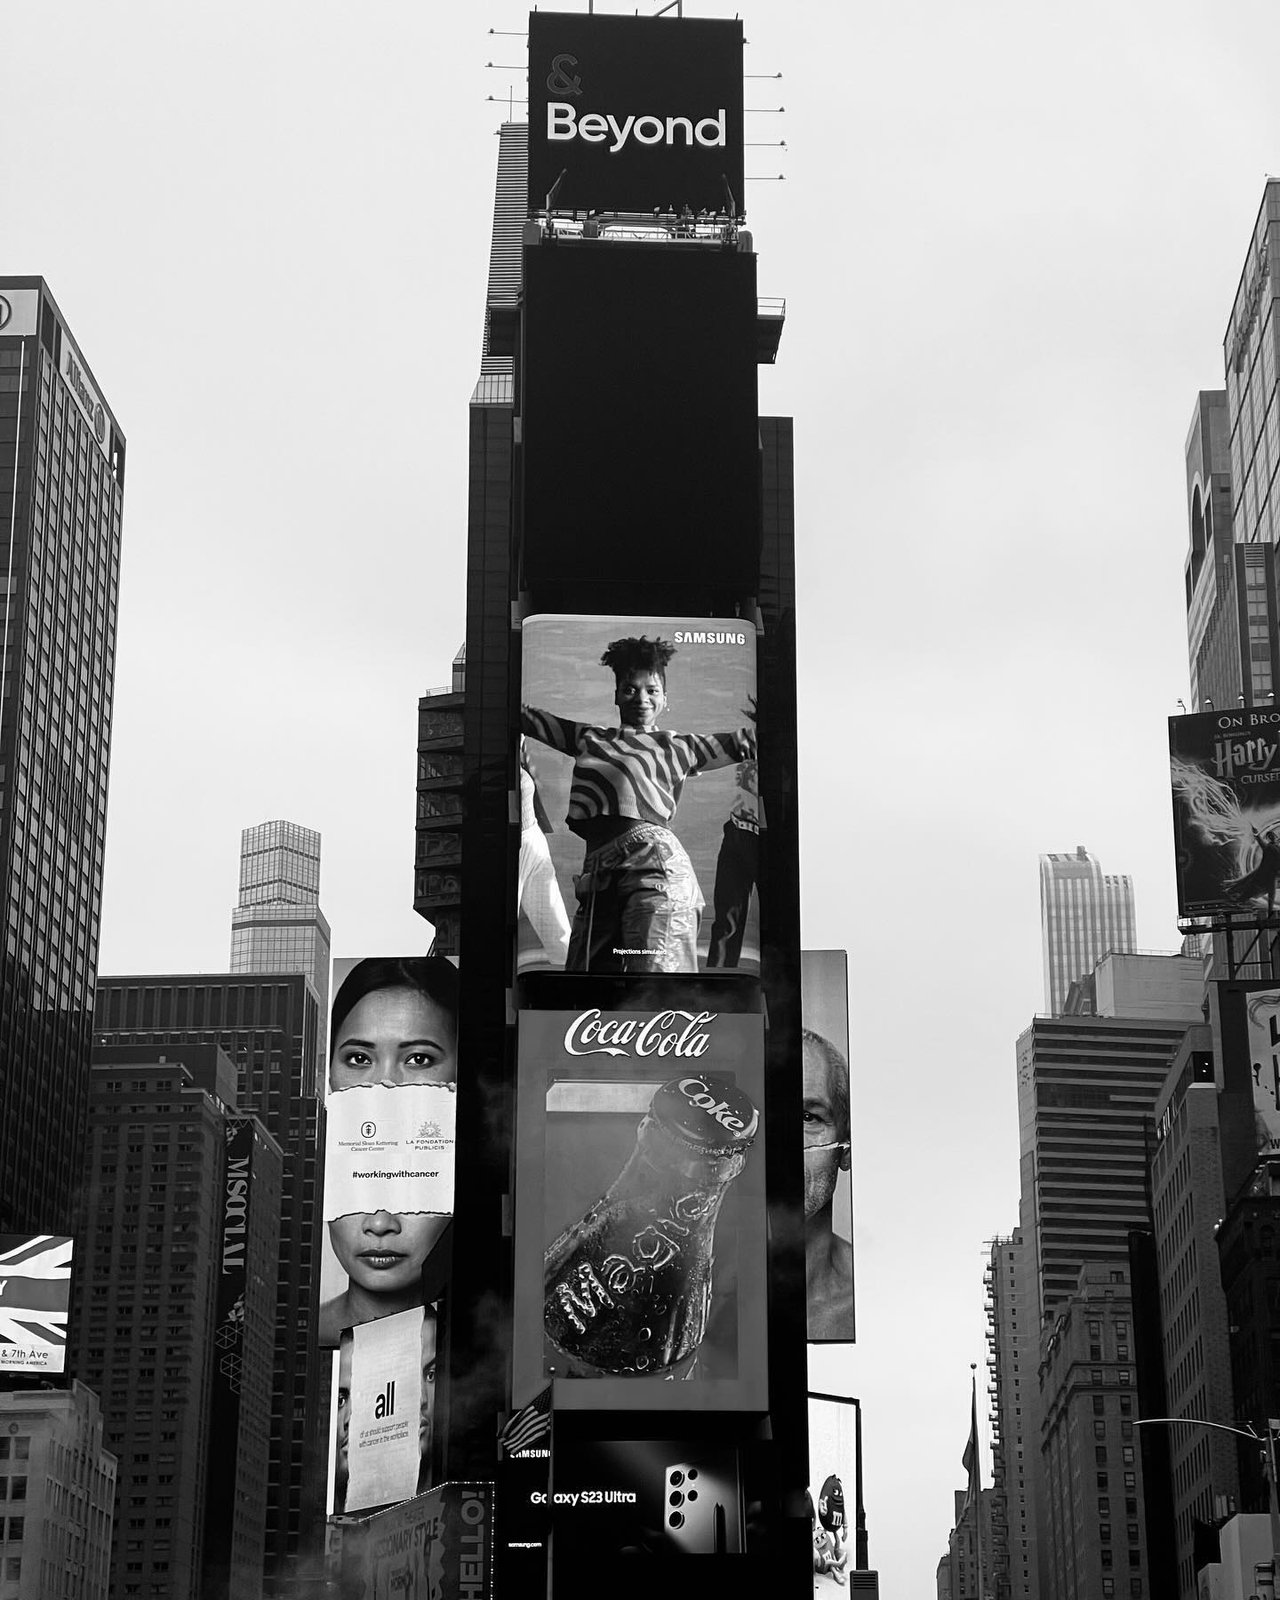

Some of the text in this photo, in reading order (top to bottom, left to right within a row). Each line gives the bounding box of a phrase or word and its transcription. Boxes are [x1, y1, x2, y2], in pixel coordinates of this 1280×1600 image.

[545, 53, 584, 96] &
[546, 102, 727, 154] Beyond
[674, 631, 746, 645] SAMSUNG
[1218, 716, 1243, 729] ON
[1210, 737, 1278, 779] Harry
[564, 1008, 718, 1058] Coca-Cola
[678, 1078, 745, 1132] Coke
[352, 1170, 439, 1180] #workingwithcancer
[28, 1350, 49, 1359] Ave
[374, 1380, 396, 1420] all
[580, 1490, 603, 1504] S23
[604, 1490, 637, 1503] Ultra
